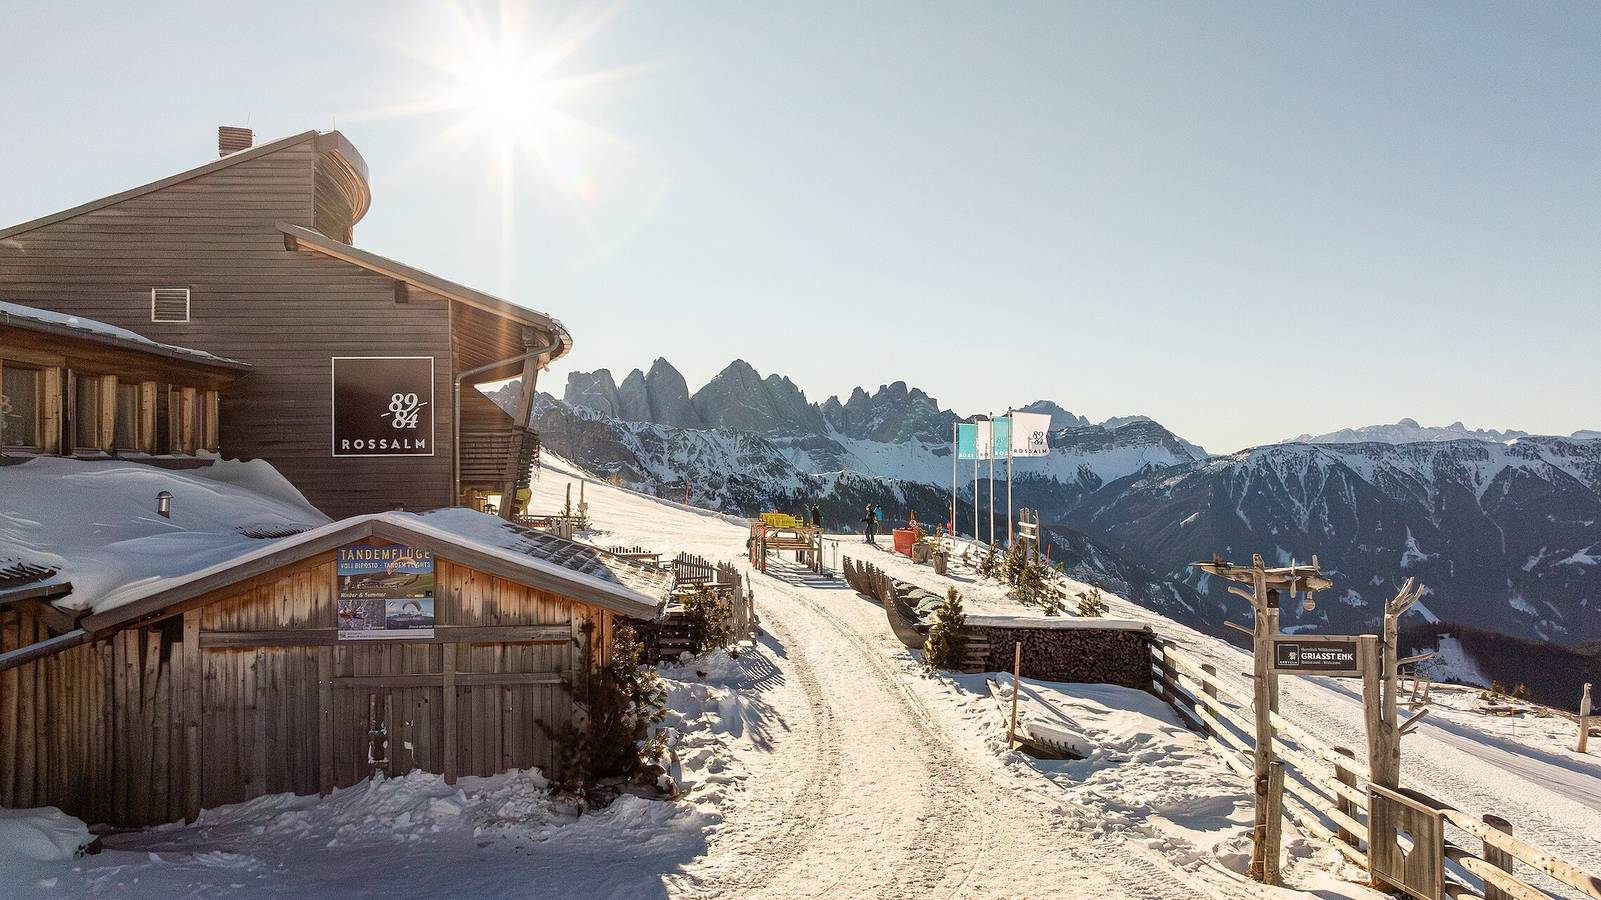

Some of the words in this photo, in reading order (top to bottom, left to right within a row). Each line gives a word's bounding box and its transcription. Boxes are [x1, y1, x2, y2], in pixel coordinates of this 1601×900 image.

[388, 393, 418, 412] 89
[391, 407, 420, 429] 84
[341, 438, 426, 450] ROSSALM
[1301, 652, 1336, 660] GRIASST
[1336, 653, 1354, 661] ENK
